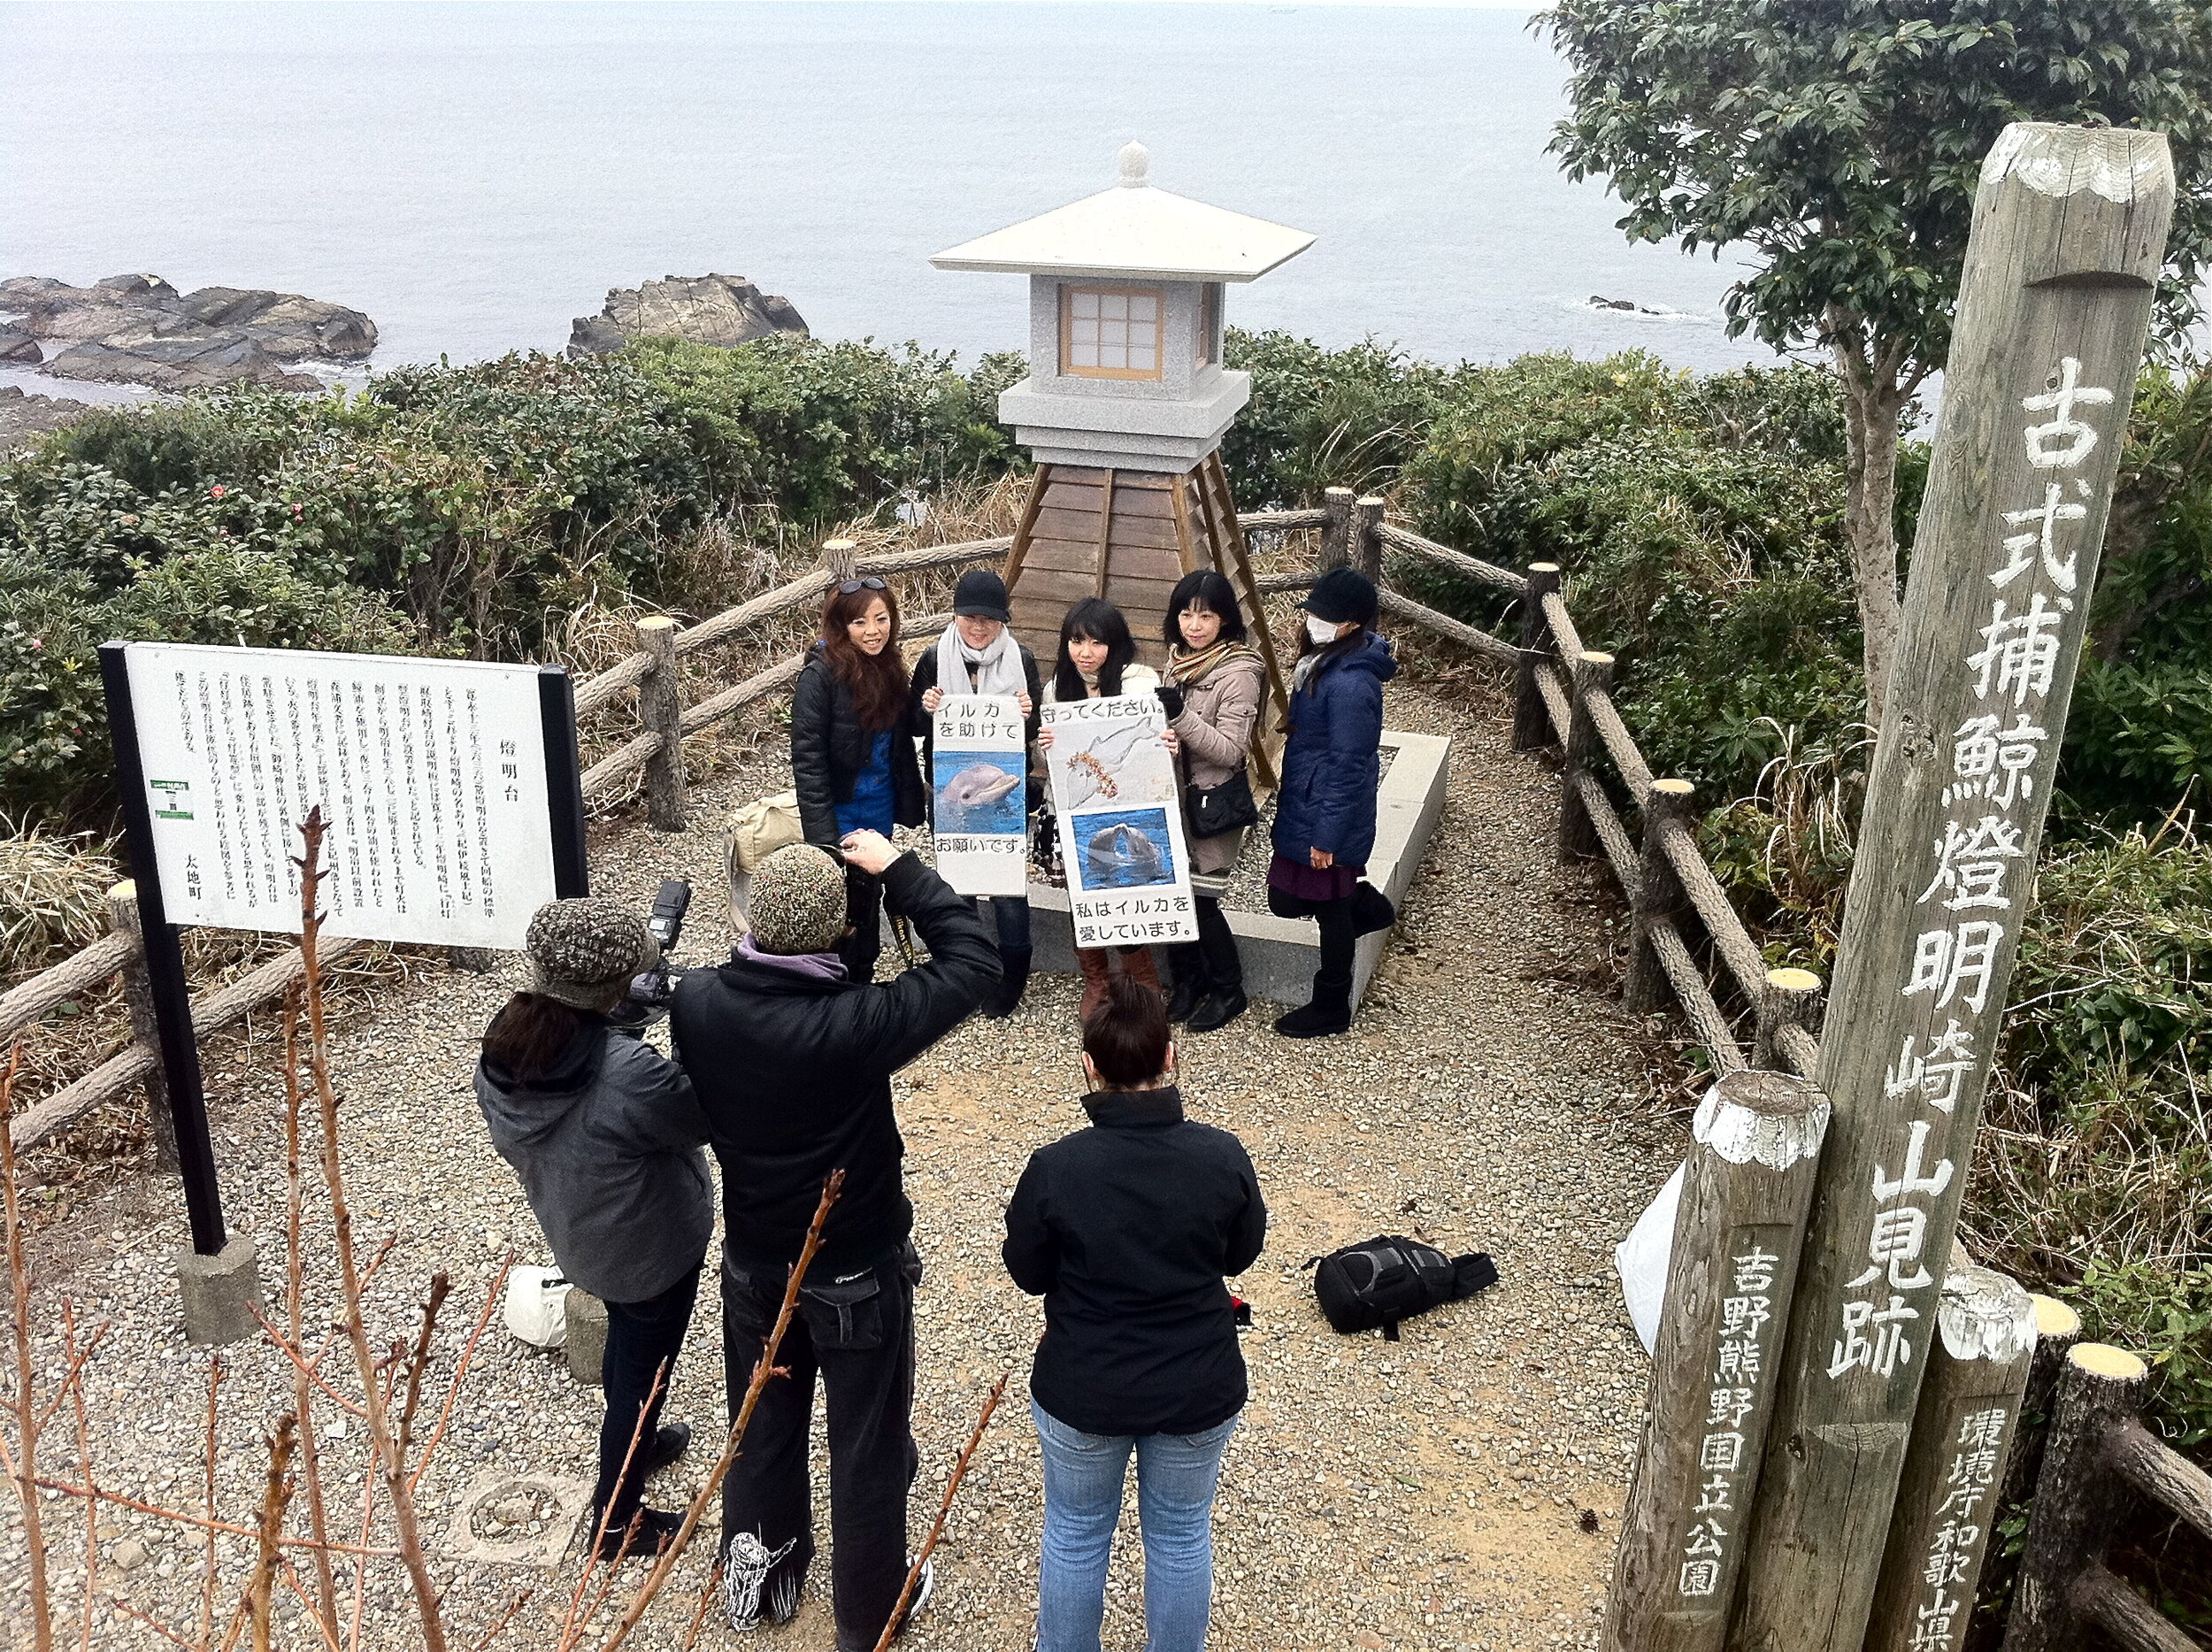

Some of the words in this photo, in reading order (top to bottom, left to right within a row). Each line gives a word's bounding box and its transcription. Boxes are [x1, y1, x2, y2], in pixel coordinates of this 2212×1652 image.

[938, 702, 1001, 719] イルカ
[1041, 699, 1164, 724] 守ってください。
[939, 721, 1018, 740] を助けて
[499, 739, 518, 802] 燈明台
[935, 837, 1025, 855] お願いです。
[186, 853, 203, 900] 太地町
[1825, 356, 2115, 1380] 古式捕鯨燈明崎山見跡
[1075, 895, 1190, 918] 私はイルカを
[1079, 920, 1191, 942] 愛しています。
[1678, 1245, 1779, 1597] 吉野熊野国立公園
